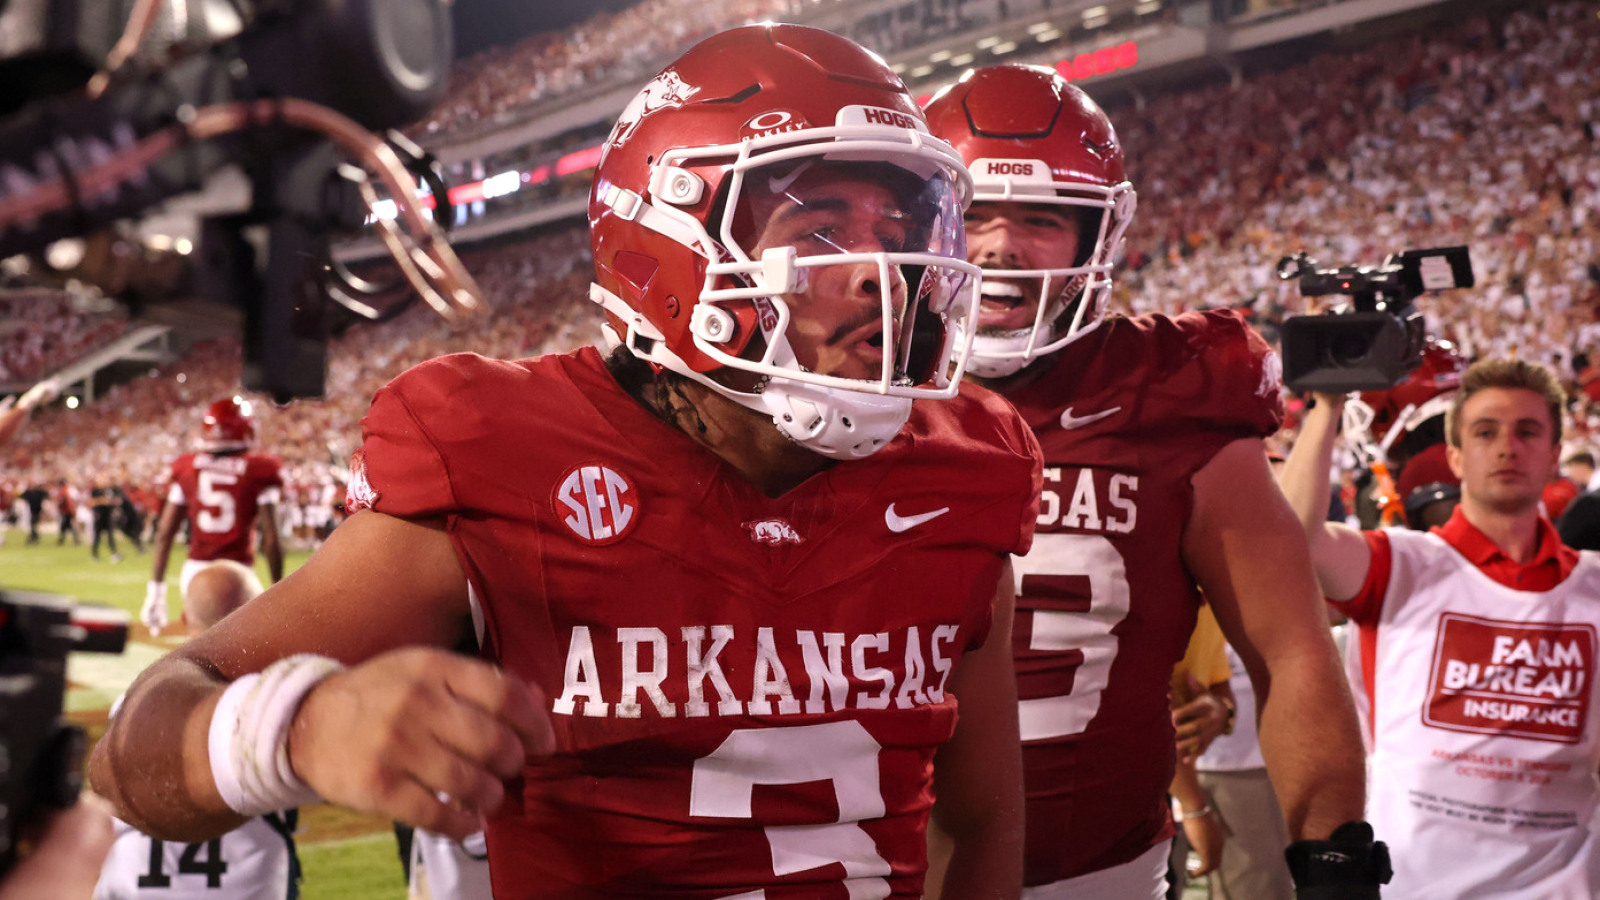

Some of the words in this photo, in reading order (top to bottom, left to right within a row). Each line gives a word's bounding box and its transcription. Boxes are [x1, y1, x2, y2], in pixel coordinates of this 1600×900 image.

[863, 107, 917, 130] HOGS
[987, 162, 1034, 176] HOGS
[196, 471, 238, 534] 5
[557, 465, 635, 541] SEC
[552, 624, 960, 719] ARKANSAS
[1491, 634, 1585, 668] FARM
[1443, 659, 1586, 699] BUREAU
[1463, 698, 1580, 727] INSURANCE
[688, 718, 892, 900] 3
[137, 832, 228, 888] 14
